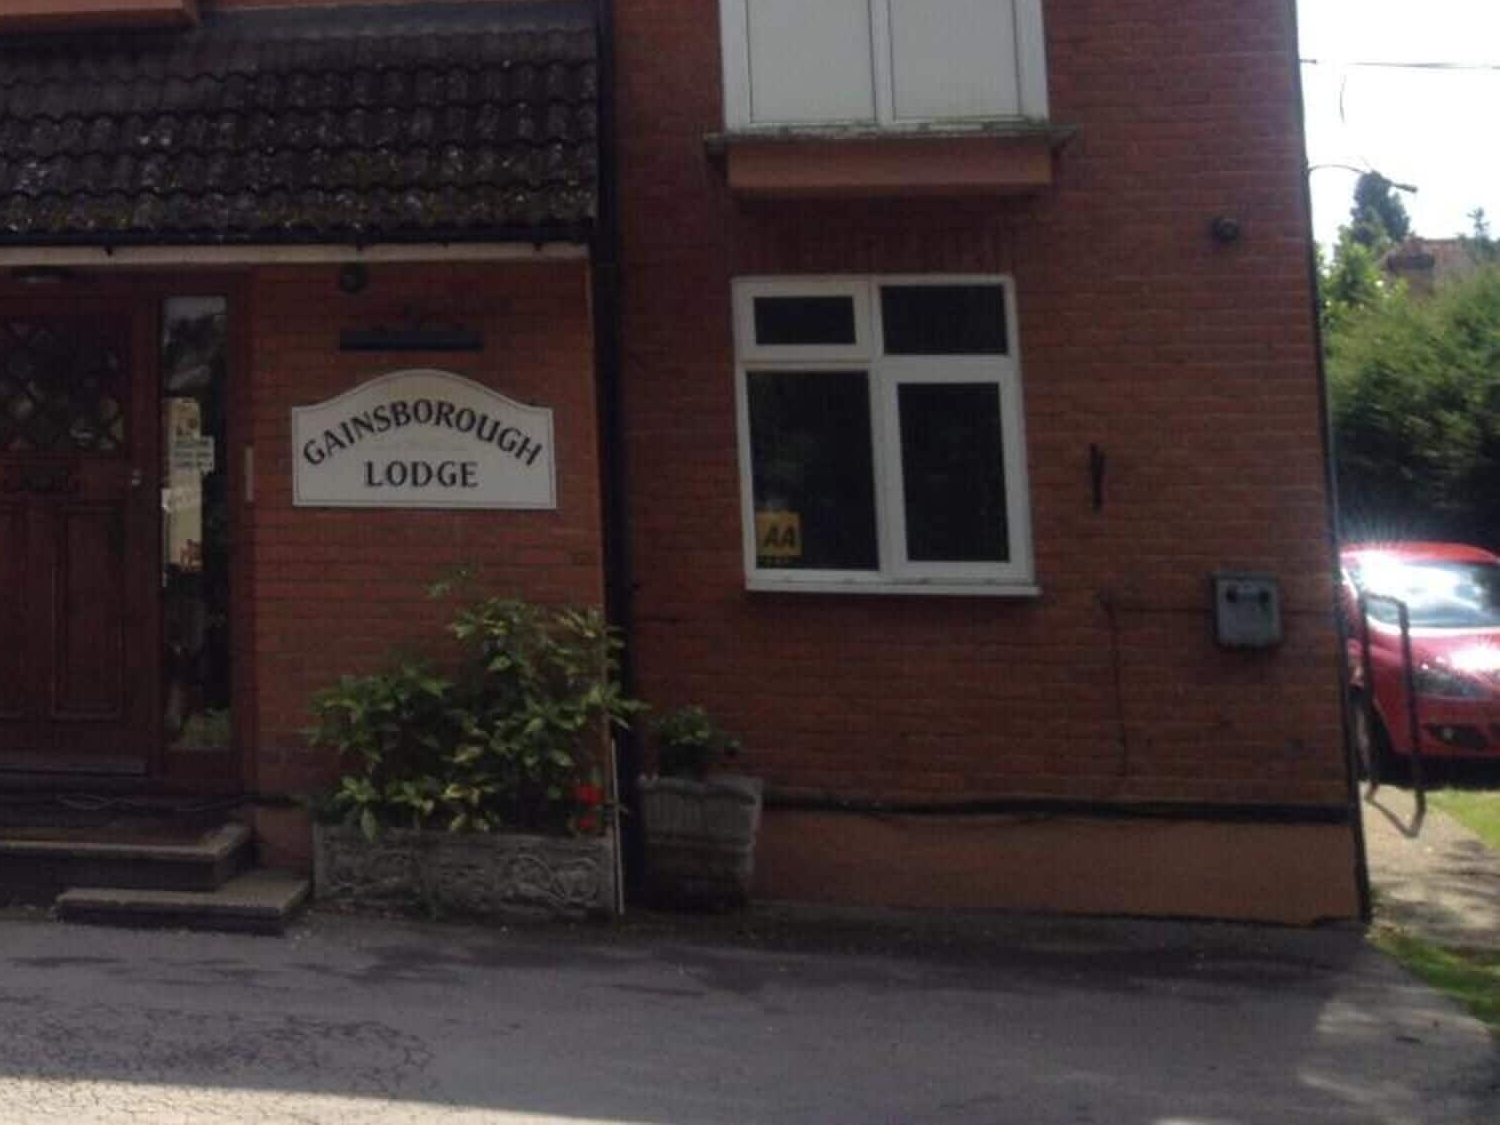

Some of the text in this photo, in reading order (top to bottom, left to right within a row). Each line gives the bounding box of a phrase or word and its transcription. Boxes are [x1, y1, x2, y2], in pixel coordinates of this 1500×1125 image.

[303, 398, 543, 466] GAINSBOROUGH
[363, 460, 480, 488] LODGE
[763, 525, 796, 548] AA
